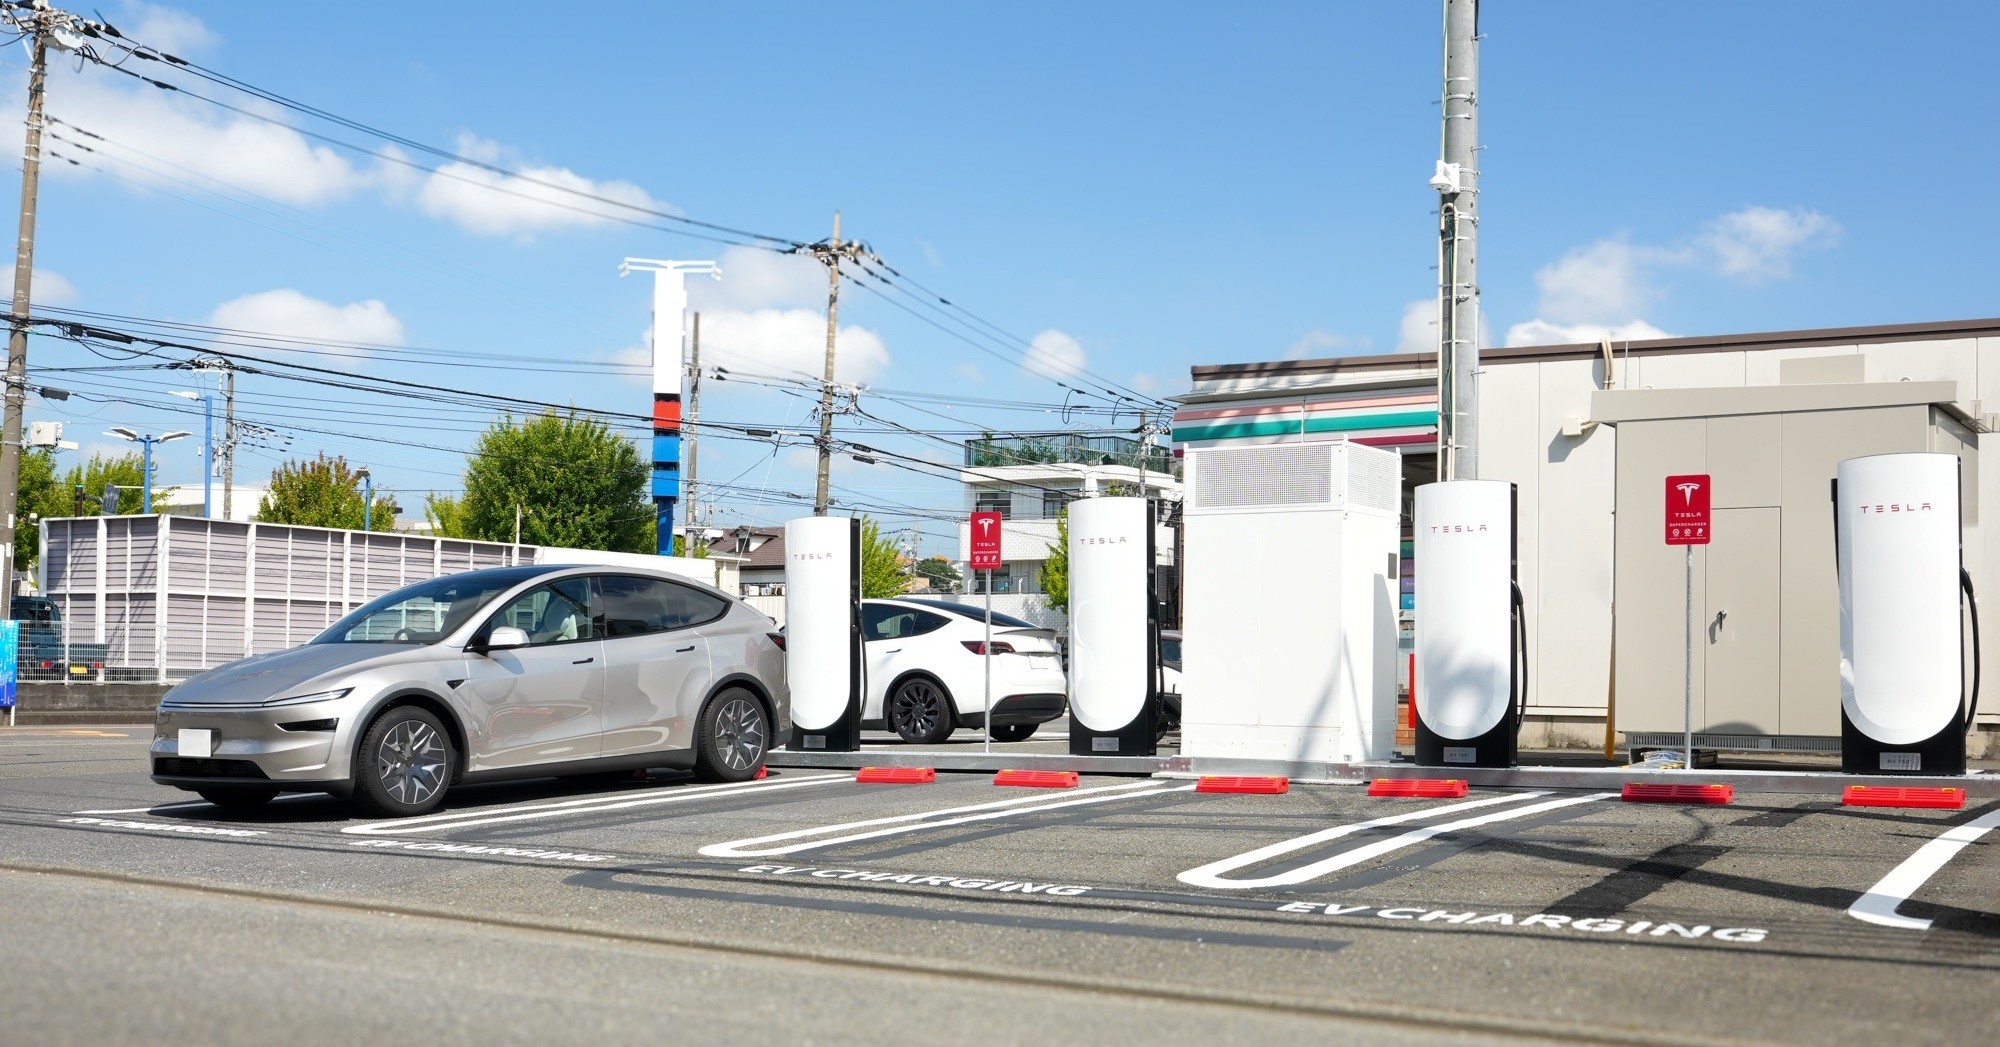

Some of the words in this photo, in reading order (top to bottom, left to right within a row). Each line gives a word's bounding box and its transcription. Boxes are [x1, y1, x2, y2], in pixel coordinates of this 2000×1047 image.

[1860, 502, 1931, 514] TESLA
[1430, 524, 1487, 534] TESLA
[1080, 536, 1126, 545] TESLA
[793, 552, 832, 561] TESLA
[403, 842, 616, 861] CHARGING
[737, 864, 816, 875] EV
[811, 869, 1092, 896] CHARGING
[1276, 901, 1371, 915] EV
[1377, 907, 1769, 943] CHARGING
